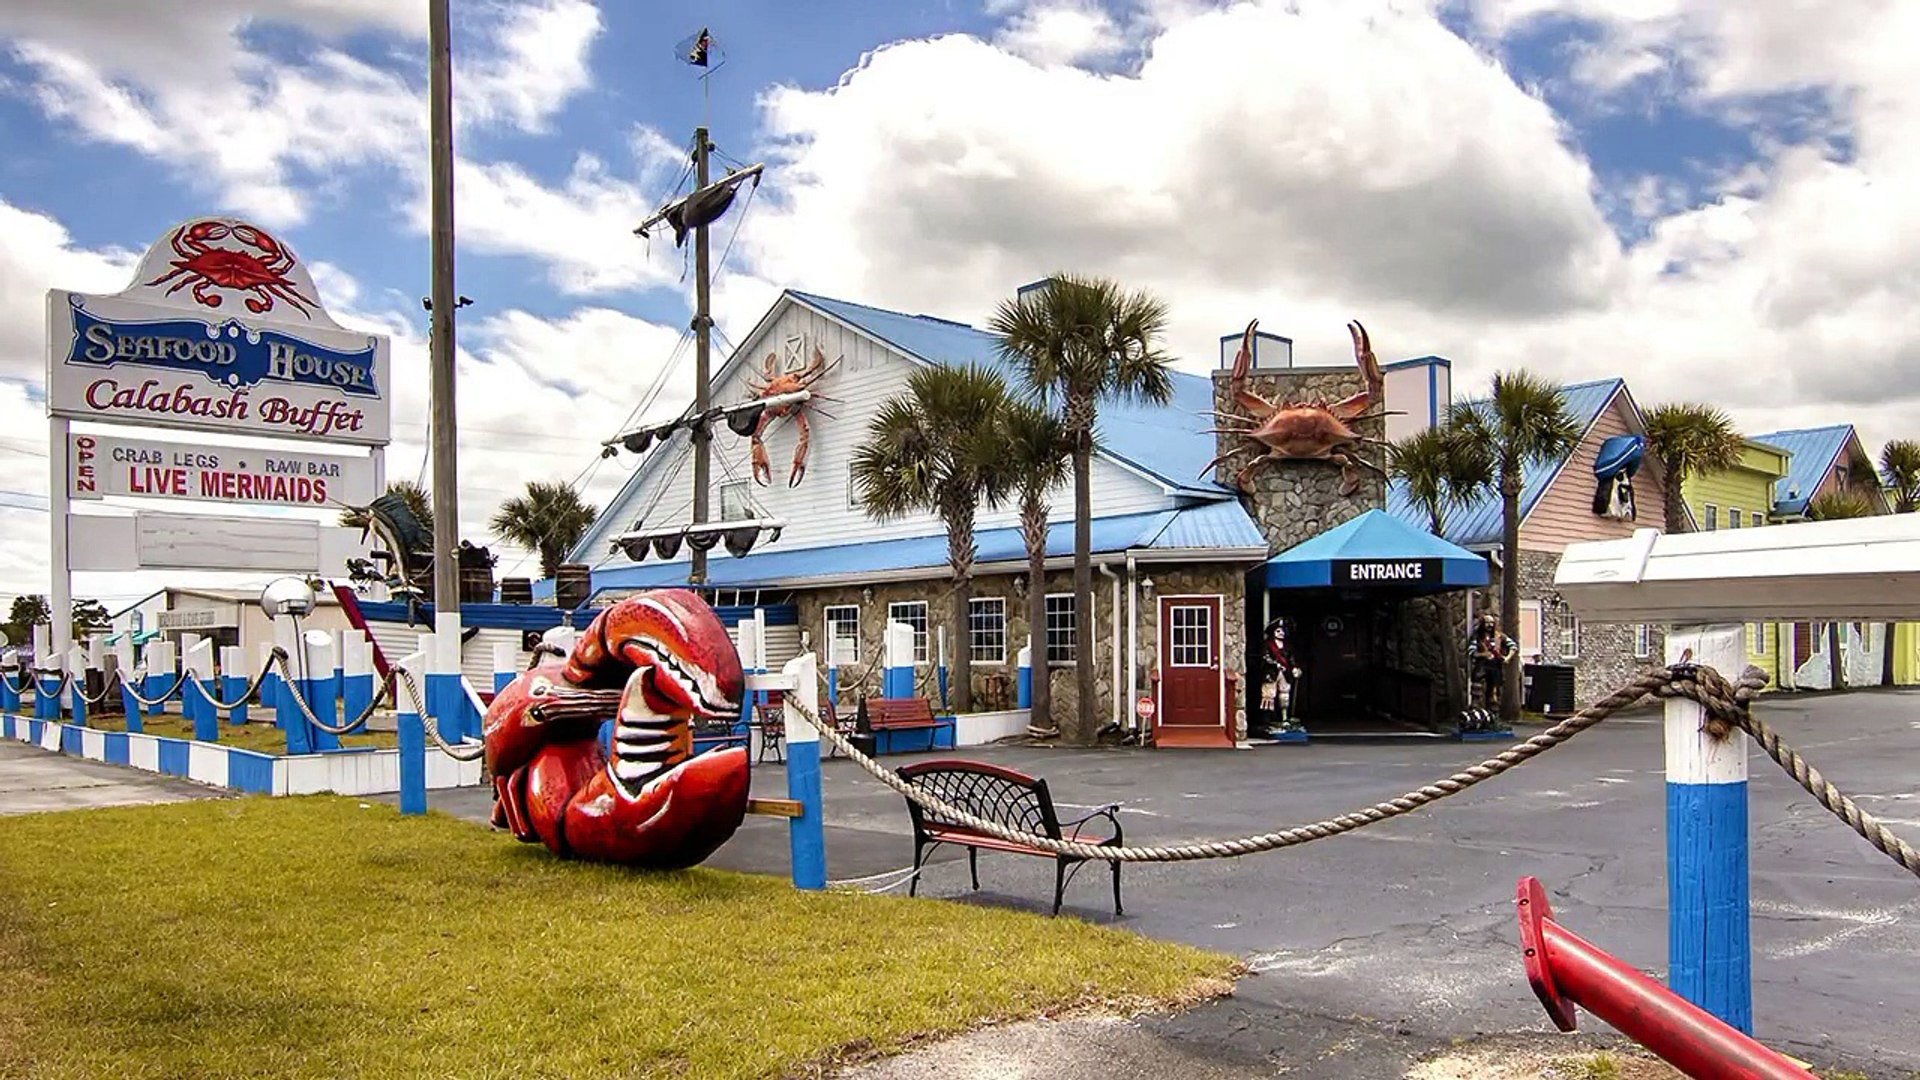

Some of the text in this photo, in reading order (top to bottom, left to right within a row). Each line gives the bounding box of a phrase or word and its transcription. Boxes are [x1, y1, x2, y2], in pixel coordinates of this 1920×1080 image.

[85, 324, 373, 388] SEAFOOD HOUSE
[86, 379, 364, 435] Calabash Buffet
[76, 436, 96, 492] OPEN
[112, 447, 339, 477] CRAB LEGS RAW BAR
[130, 467, 326, 504] LIVE MERMAIDS
[1350, 563, 1422, 579] ENTRANCE
